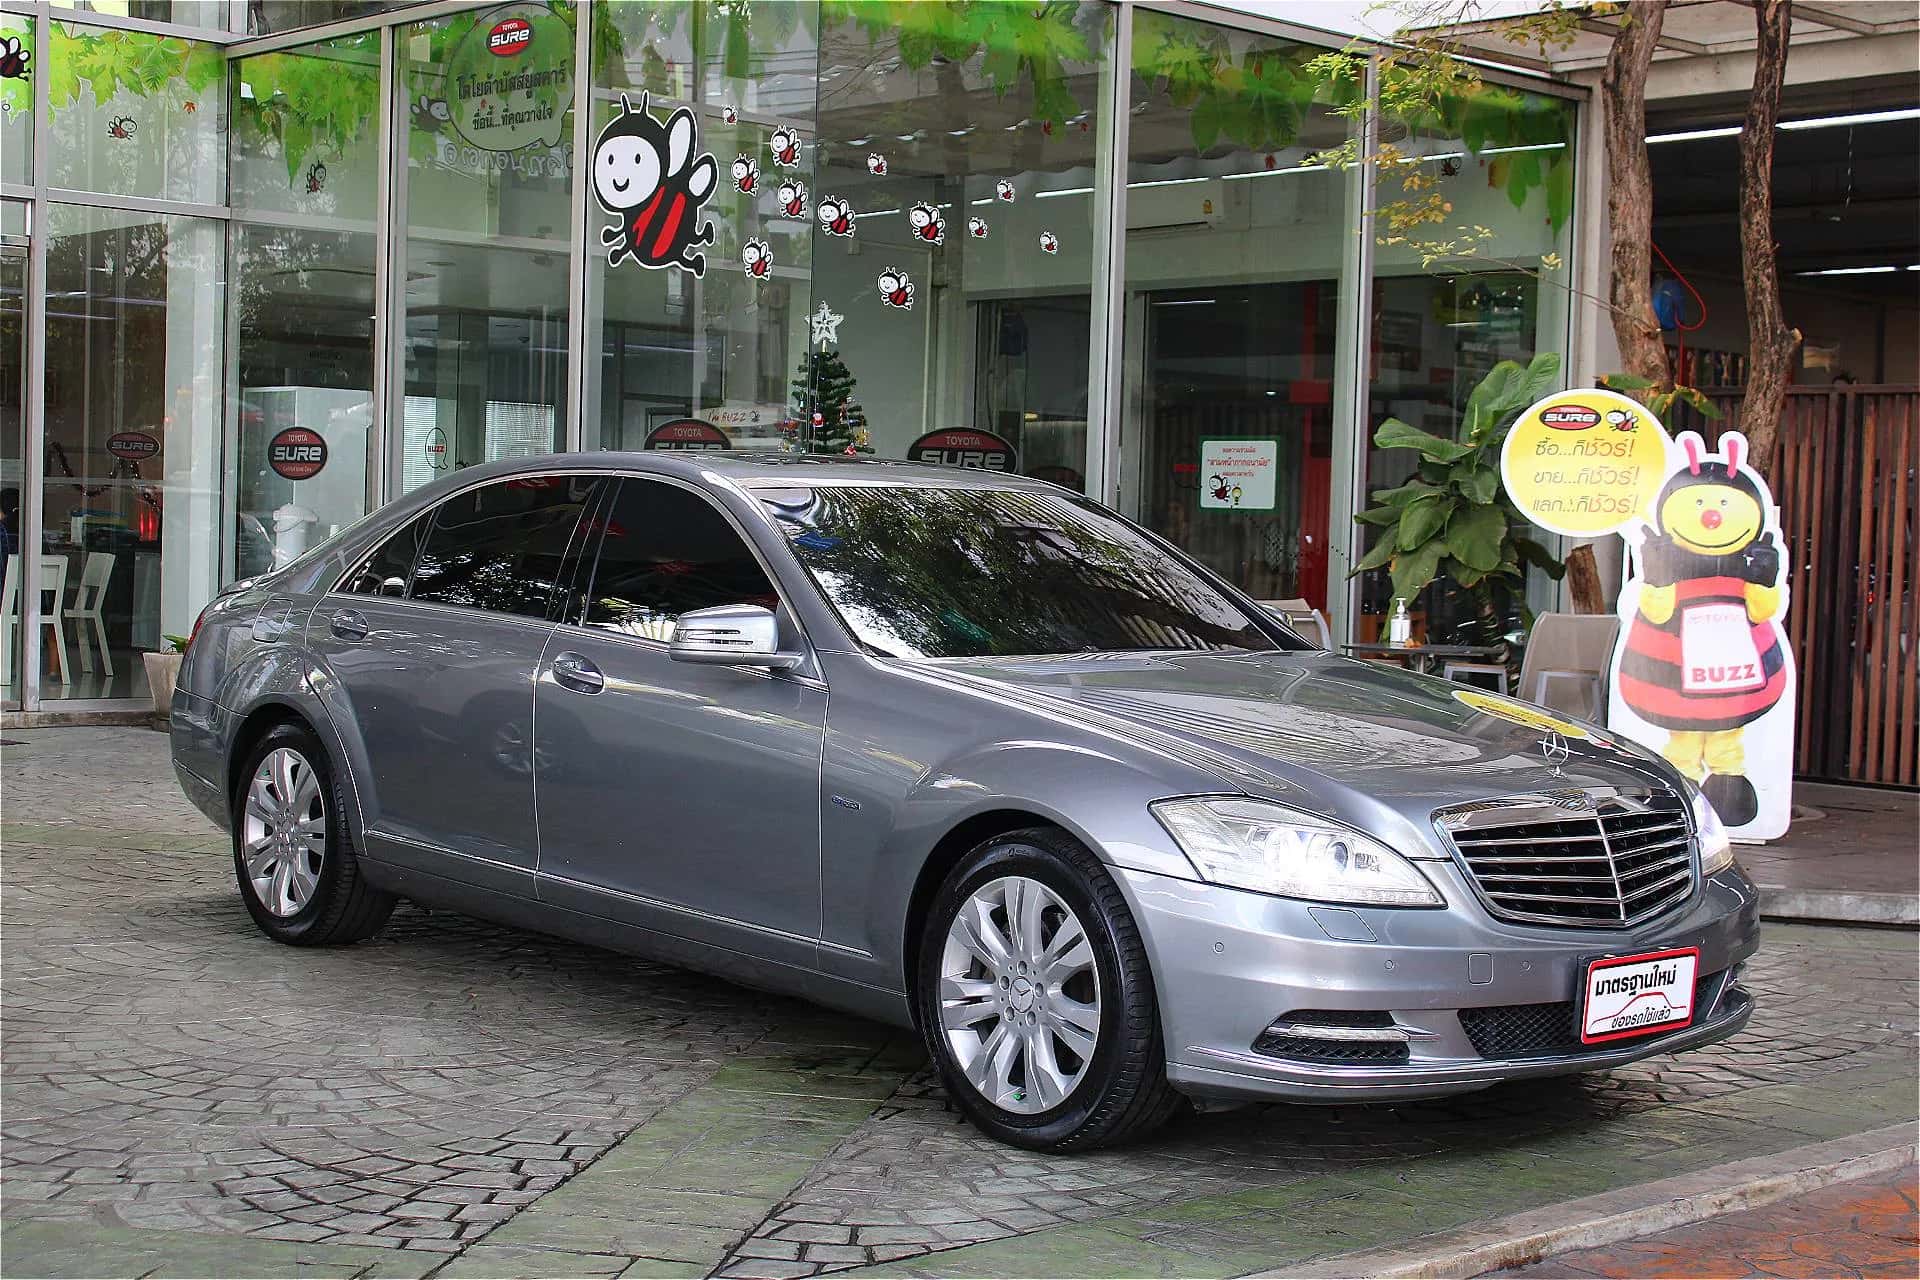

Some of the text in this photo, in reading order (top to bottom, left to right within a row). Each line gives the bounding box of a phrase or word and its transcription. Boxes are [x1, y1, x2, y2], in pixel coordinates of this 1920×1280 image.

[490, 29, 530, 47] SURE
[1544, 412, 1597, 422] SURE
[288, 434, 308, 442] TOYOTA
[673, 427, 703, 437] TOYOTA
[111, 441, 154, 451] SURE
[946, 435, 981, 446] TOYOTA
[273, 446, 322, 461] SURE
[920, 450, 1006, 470] SURE
[1692, 664, 1756, 683] BUZZ
[1595, 964, 1677, 996] มาตรฐานใหม่
[1611, 1005, 1671, 1029] ของรถใช้แล้ว
